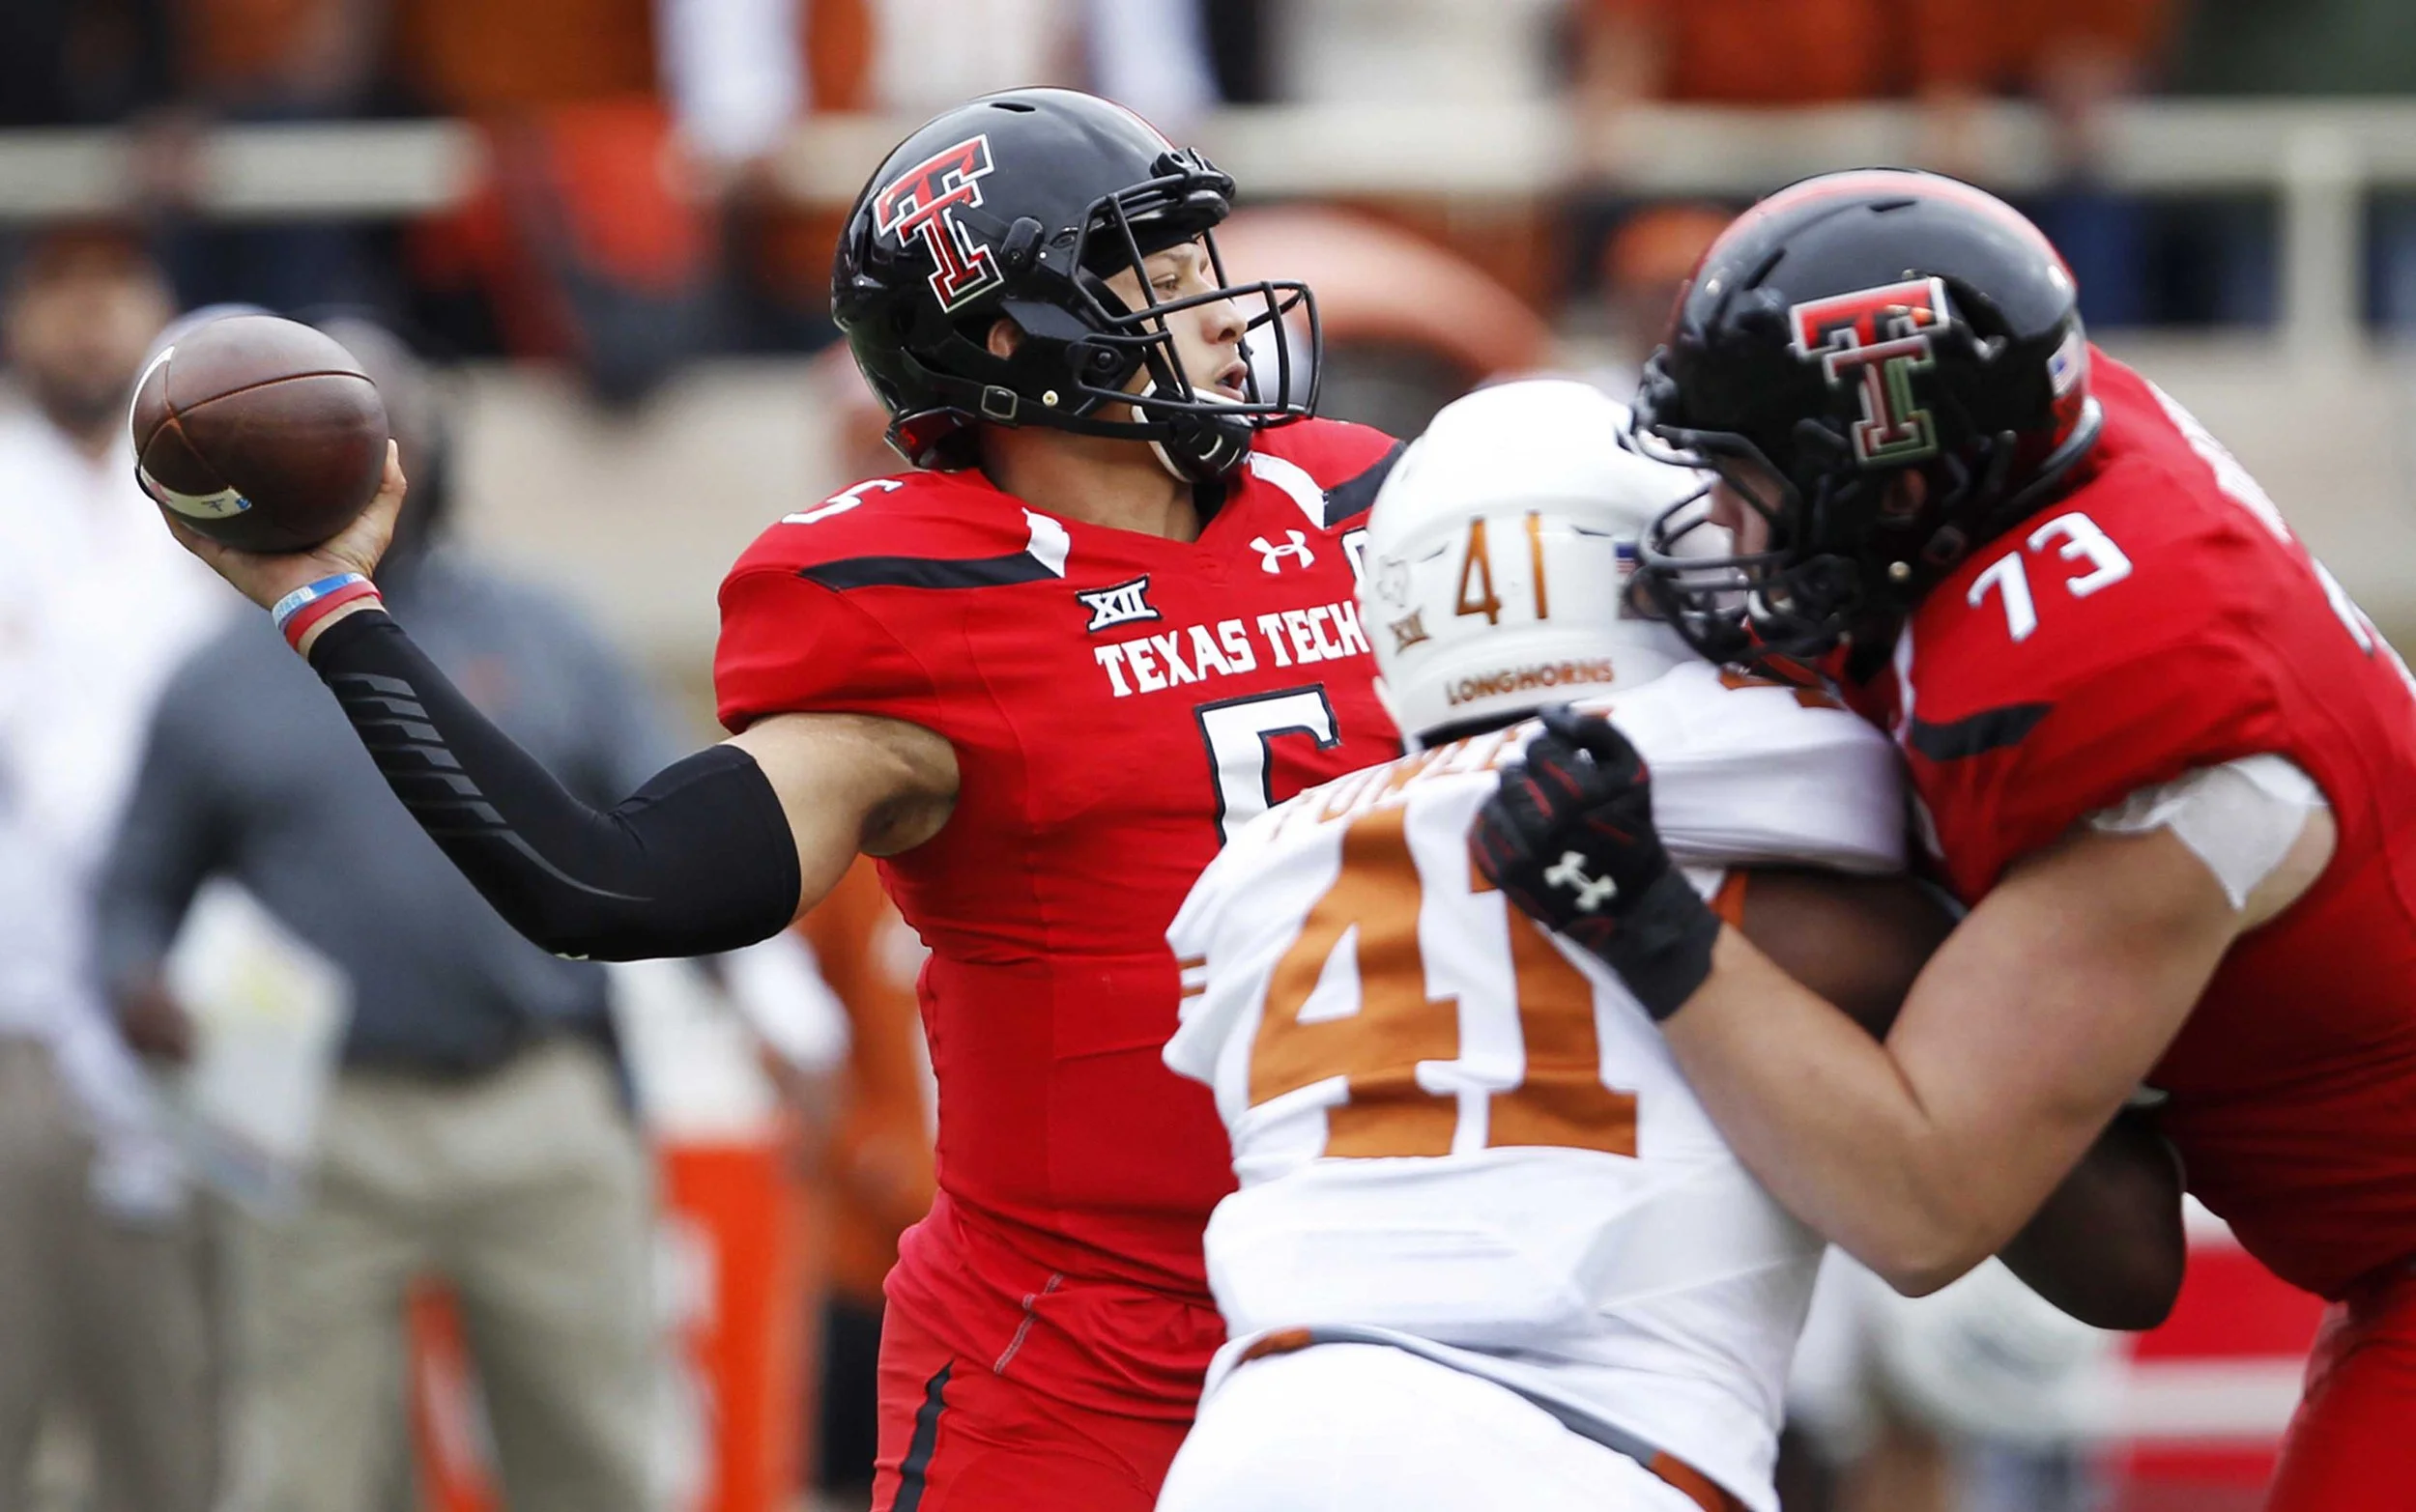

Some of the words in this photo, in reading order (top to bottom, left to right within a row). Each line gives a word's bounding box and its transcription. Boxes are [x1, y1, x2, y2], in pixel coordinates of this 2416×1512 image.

[1076, 574, 1164, 634] XII
[1455, 508, 1550, 626] 41
[1967, 510, 2133, 642] 73
[1094, 617, 1257, 698] TEXAS
[1257, 600, 1371, 669] TECH
[1446, 656, 1617, 707] LONGHORNS
[1247, 802, 1638, 1159] 41
